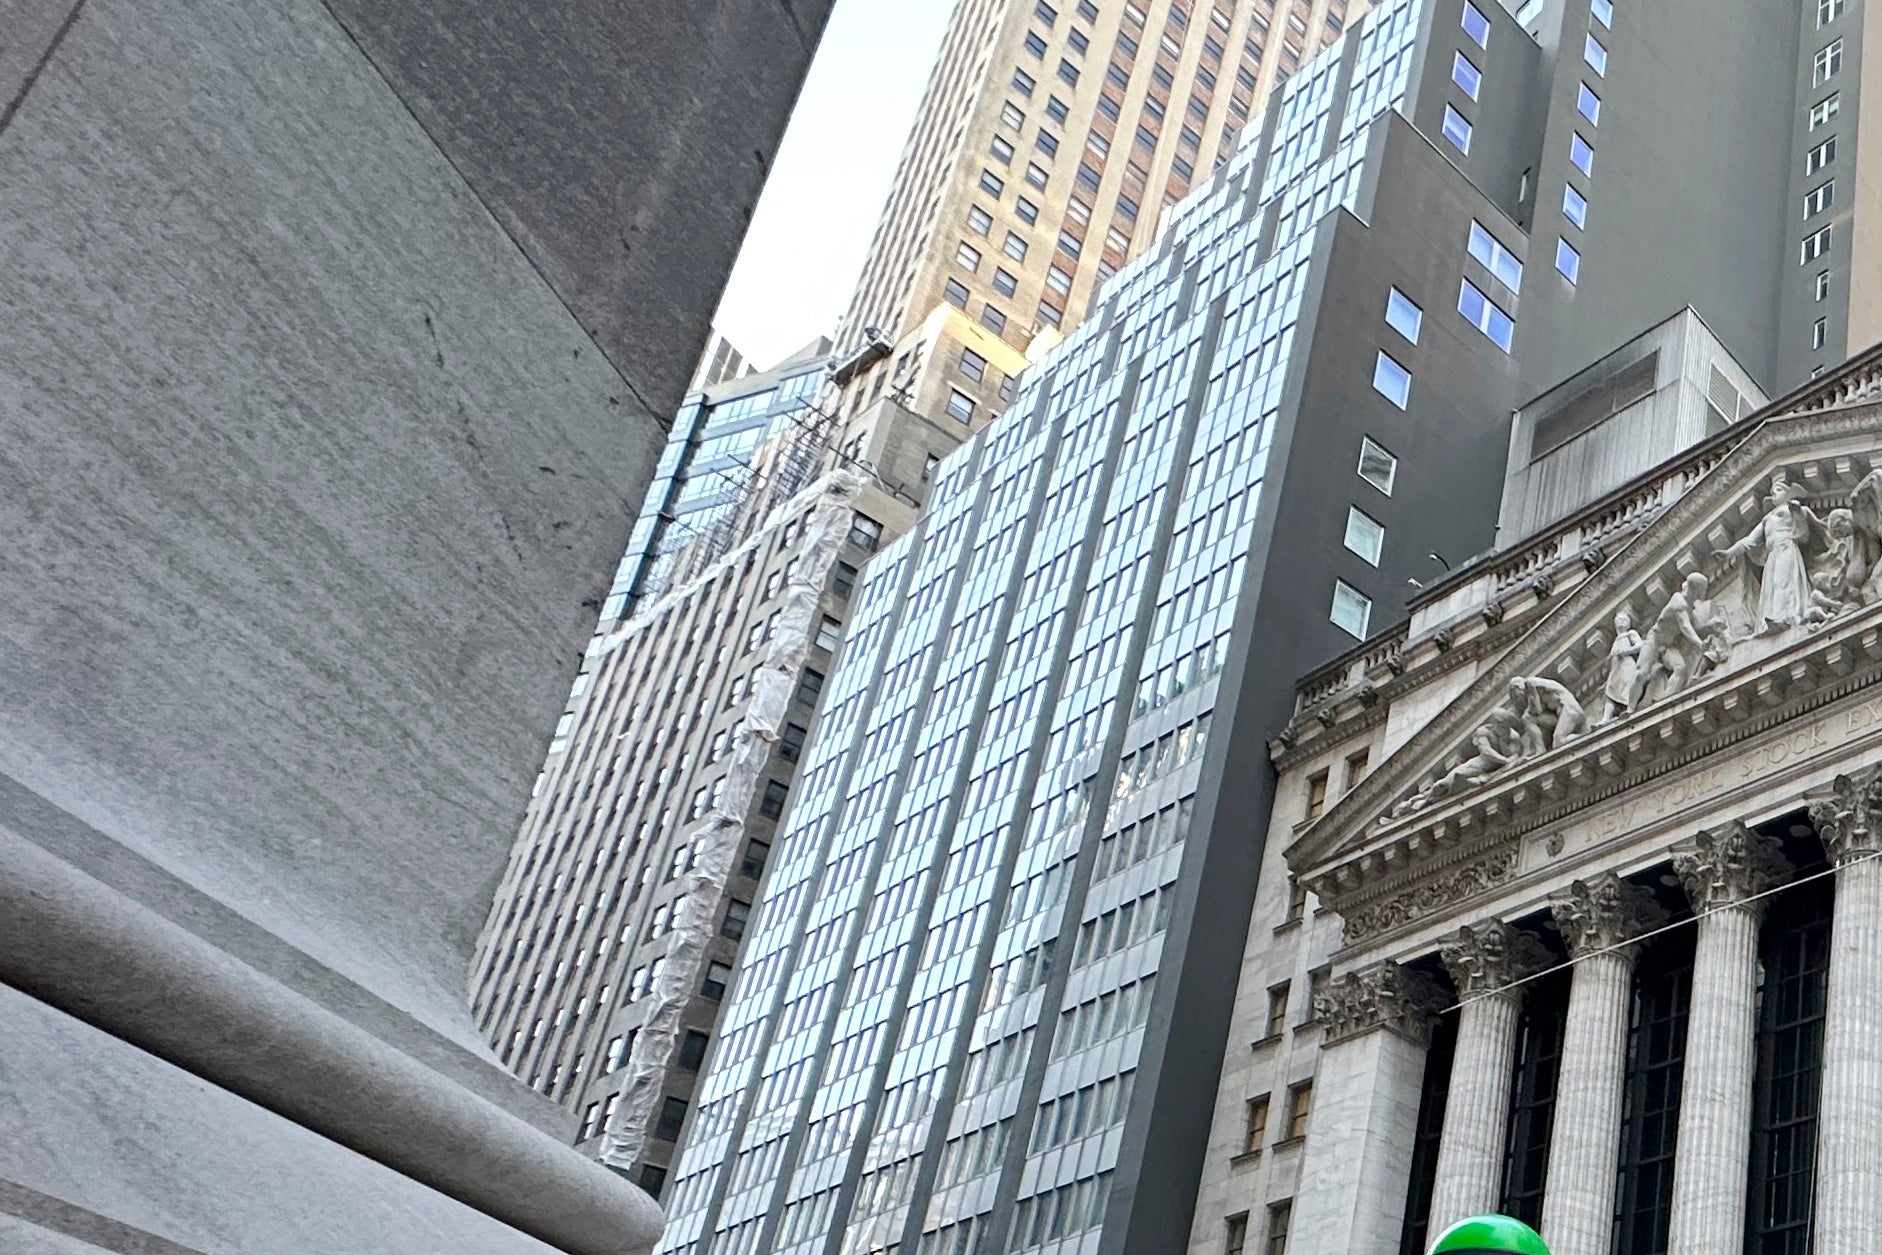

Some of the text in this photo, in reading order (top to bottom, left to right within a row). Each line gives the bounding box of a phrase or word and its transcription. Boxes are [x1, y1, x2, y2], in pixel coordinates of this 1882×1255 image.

[1584, 801, 1640, 843] NEW
[1652, 769, 1723, 814] YORK
[1740, 722, 1828, 778] STOCK
